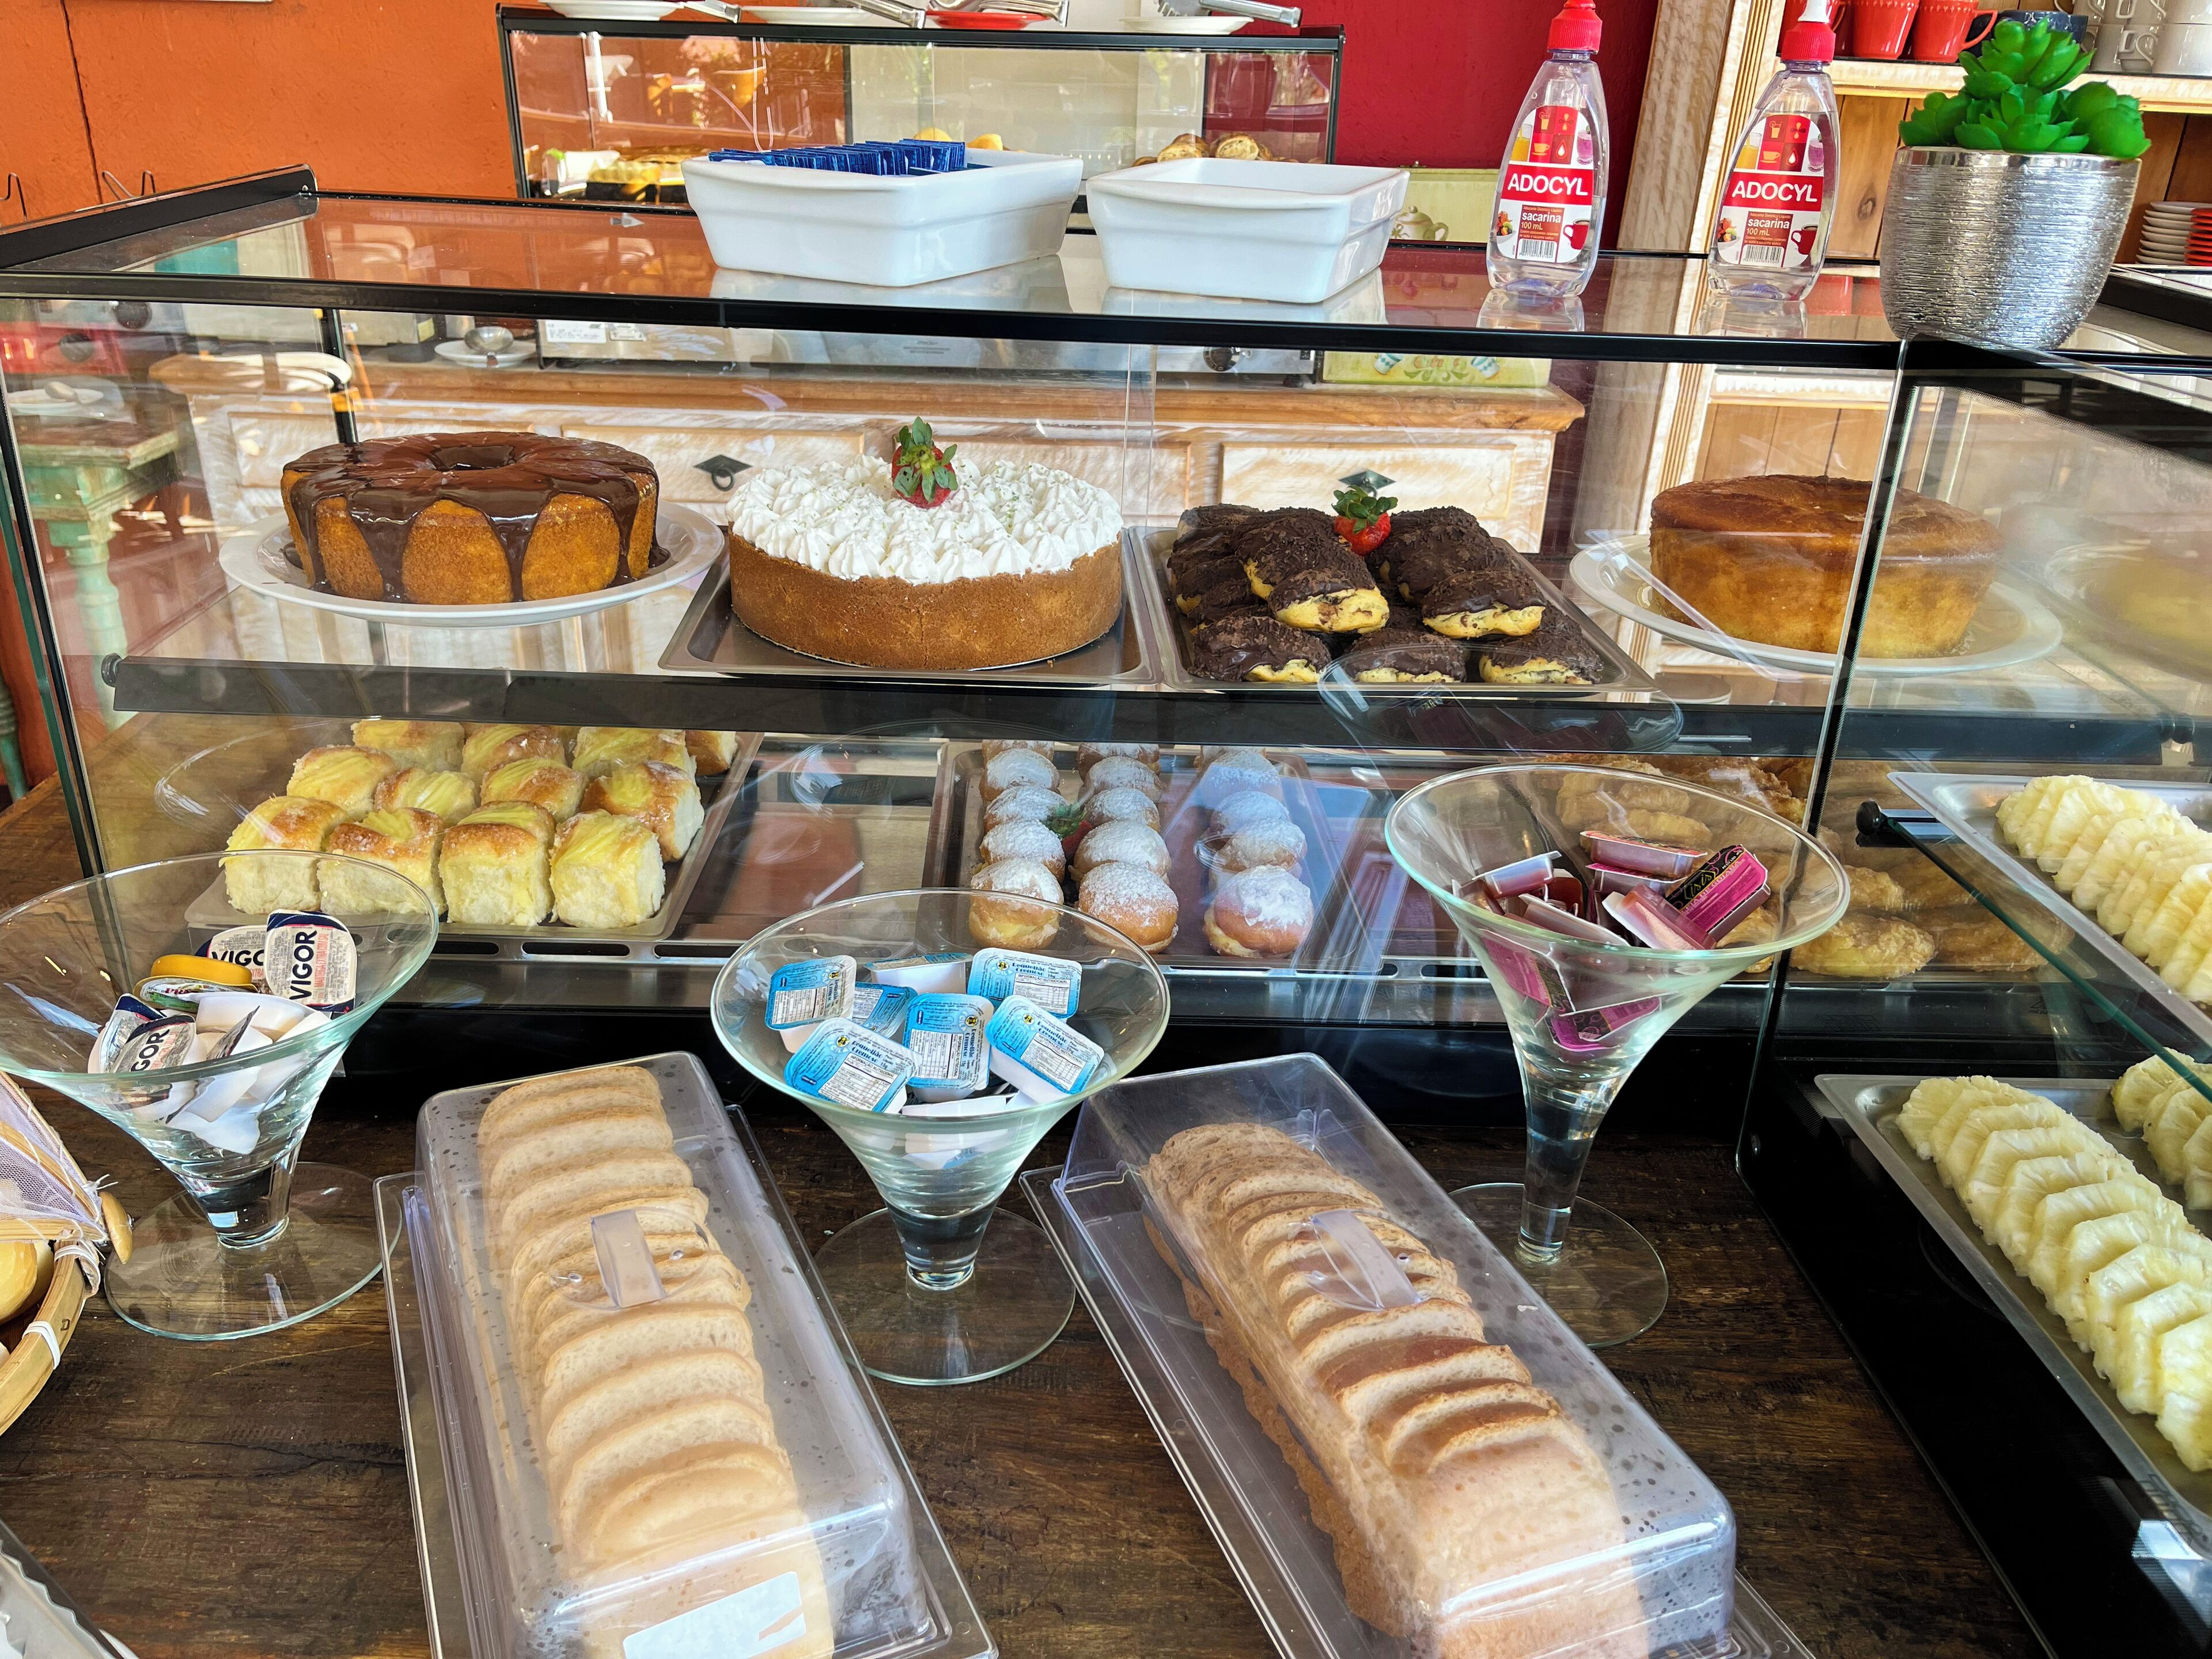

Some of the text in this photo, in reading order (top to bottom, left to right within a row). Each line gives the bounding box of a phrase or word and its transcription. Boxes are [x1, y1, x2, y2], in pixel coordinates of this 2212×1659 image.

[1507, 173, 1588, 196] ADOCYL
[1732, 180, 1817, 202] ADOCYL
[1522, 212, 1561, 223] sacarina
[1748, 218, 1790, 229] sacarina
[1532, 222, 1543, 230] mL
[1747, 228, 1758, 236] 100
[289, 930, 317, 999] VIGOR
[850, 1055, 895, 1078] INFORMAÇÃO NUTRICIONAL
